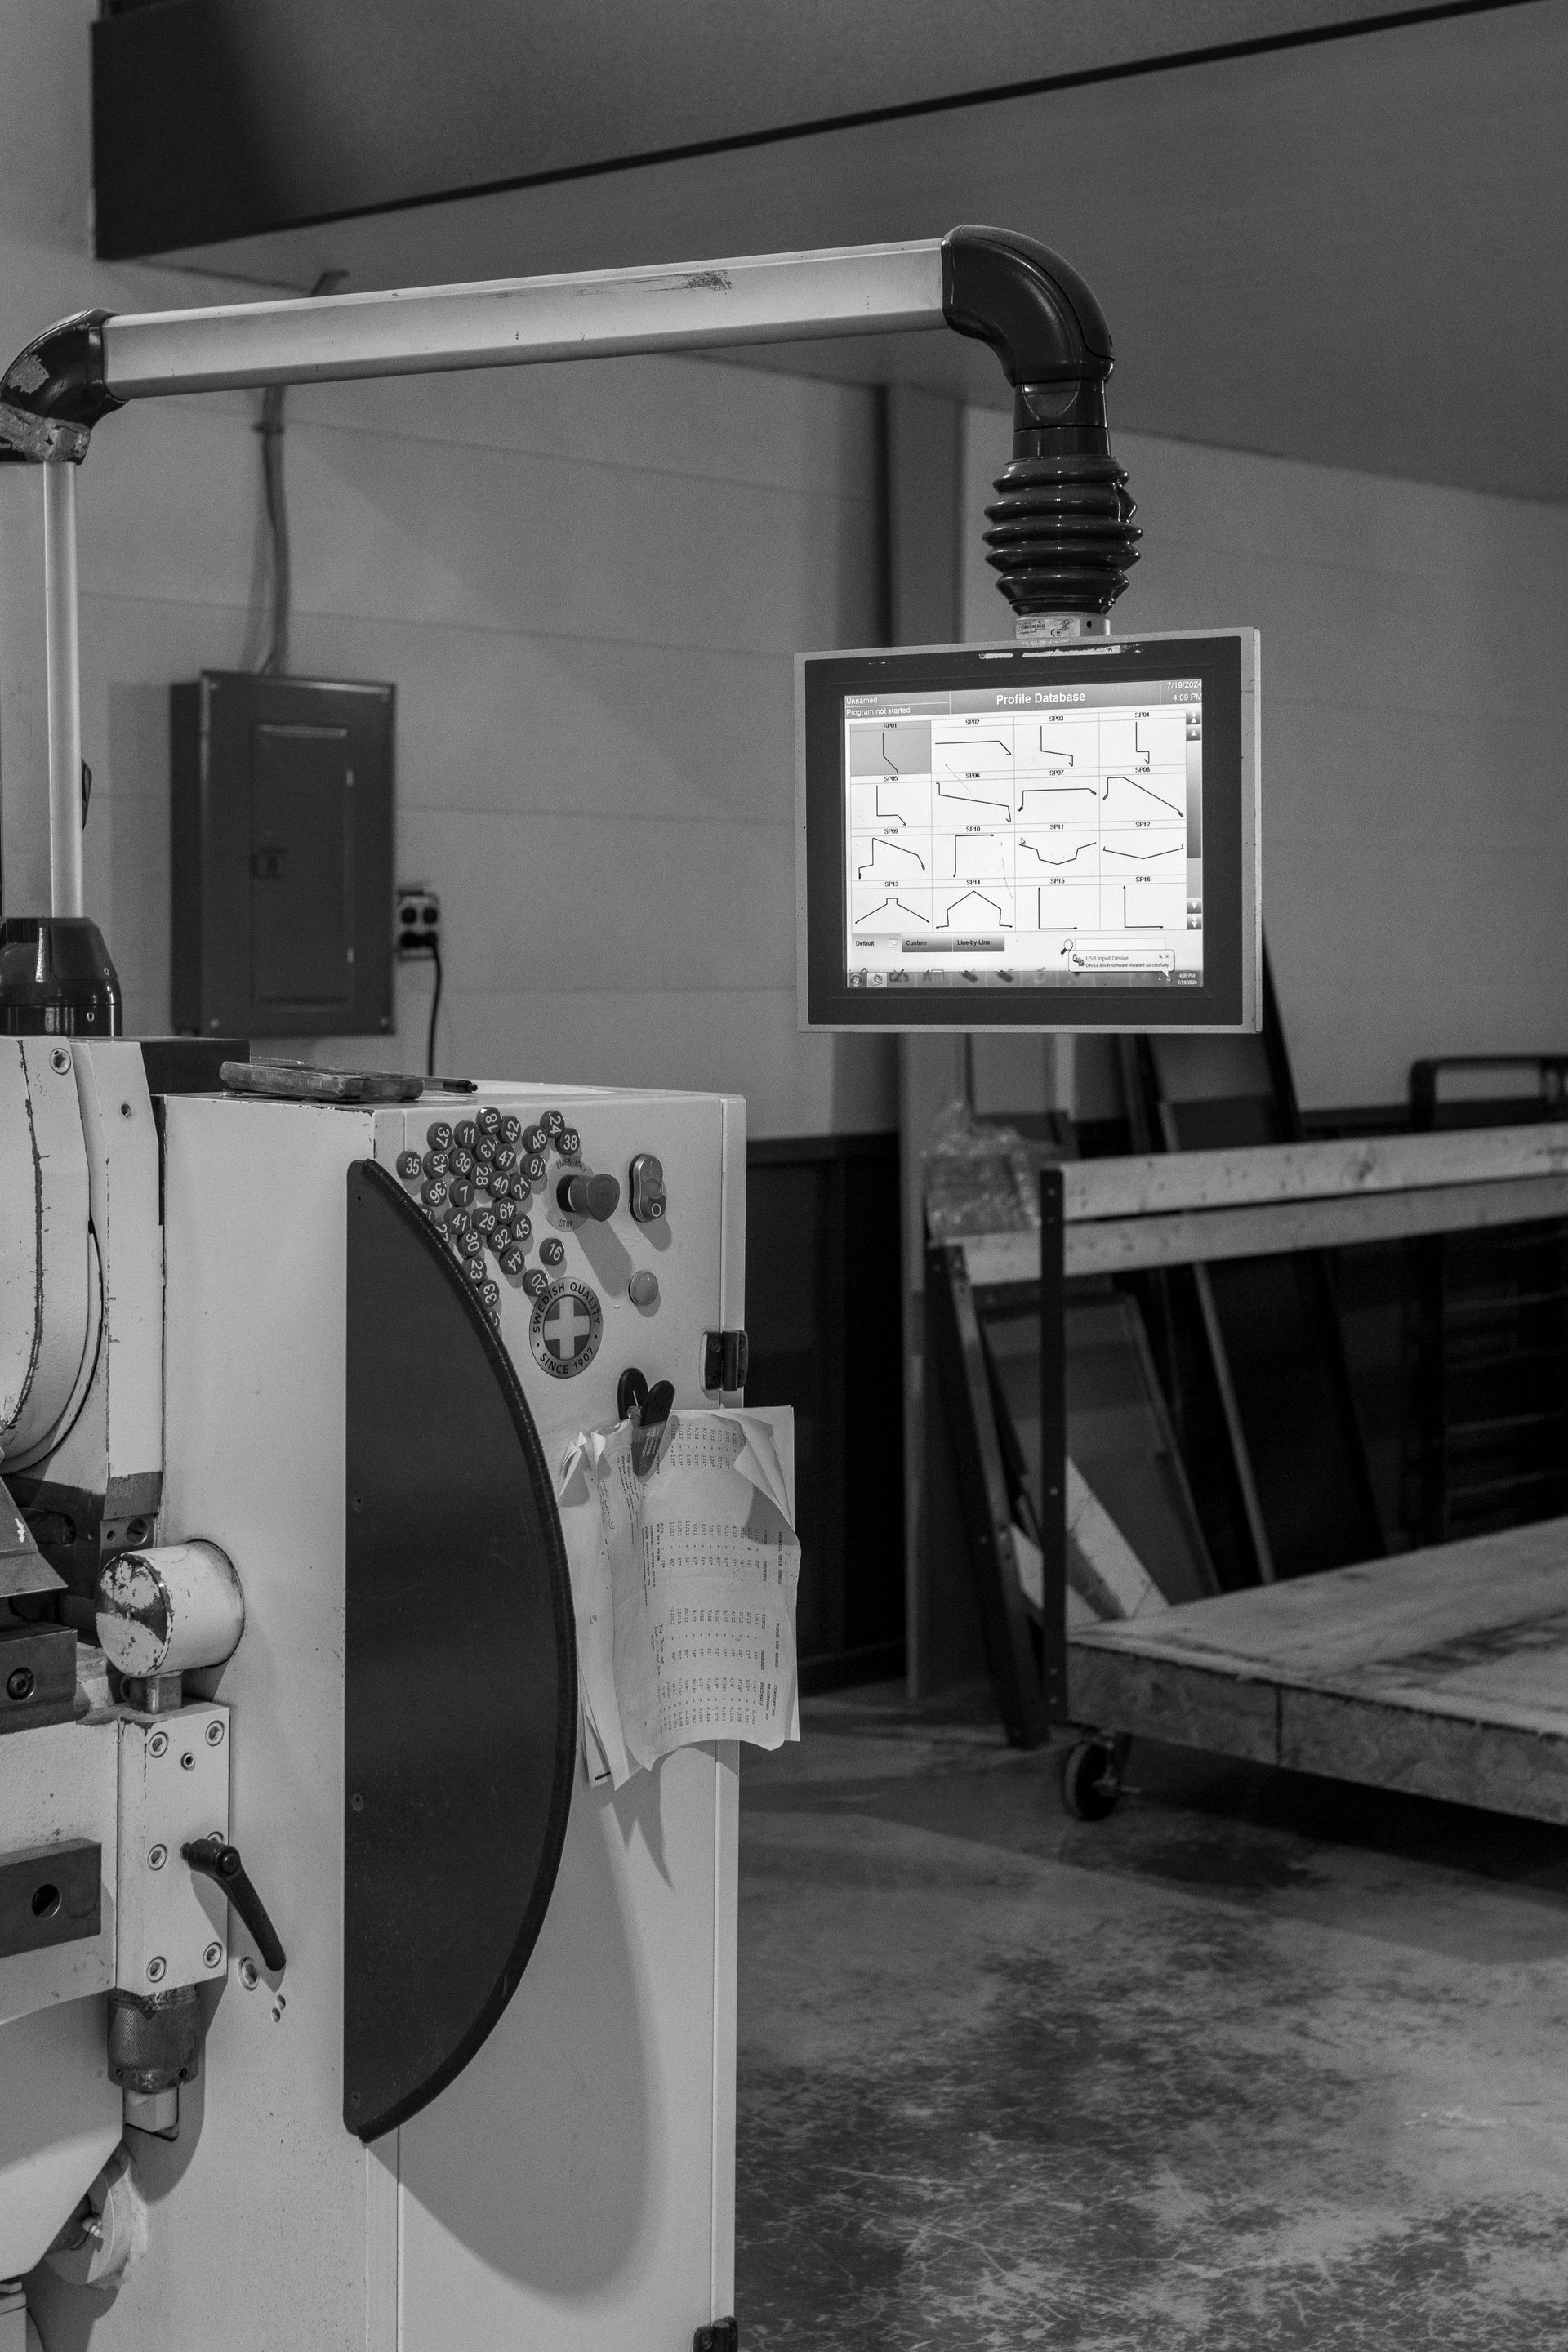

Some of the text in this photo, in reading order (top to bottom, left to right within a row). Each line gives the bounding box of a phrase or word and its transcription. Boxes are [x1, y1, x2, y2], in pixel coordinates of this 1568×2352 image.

[1167, 681, 1202, 689] 7/19/2024
[996, 691, 1086, 705] Profile Database
[846, 708, 874, 716] Program
[506, 1121, 519, 1141] 42
[549, 1115, 561, 1135] 24
[436, 1127, 449, 1148] 37
[464, 1127, 475, 1143] 11
[533, 1130, 546, 1149] 46
[564, 1134, 577, 1150] 38
[406, 1157, 419, 1174] 35
[433, 1154, 446, 1173] 43
[456, 1153, 471, 1172] 39
[499, 1150, 515, 1167] 47
[556, 1158, 588, 1173] EMERGENCY
[476, 1166, 488, 1185] 28
[493, 1176, 508, 1194] 40
[460, 1186, 468, 1202] 7
[514, 1177, 529, 1199] 21
[500, 1203, 514, 1219] 49
[453, 1213, 467, 1231] 41
[479, 1212, 495, 1230] 29
[516, 1219, 529, 1238] 45
[559, 1218, 574, 1228] STOP
[466, 1232, 479, 1251] 30
[495, 1229, 511, 1249] 32
[508, 1251, 521, 1271] 44
[549, 1243, 562, 1261] 16
[470, 1260, 483, 1279] 23
[483, 1283, 497, 1303] 33
[531, 1274, 547, 1294] 20
[533, 1282, 601, 1333] SWEDISH QUALITY
[540, 1346, 593, 1374] SINCE 1907
